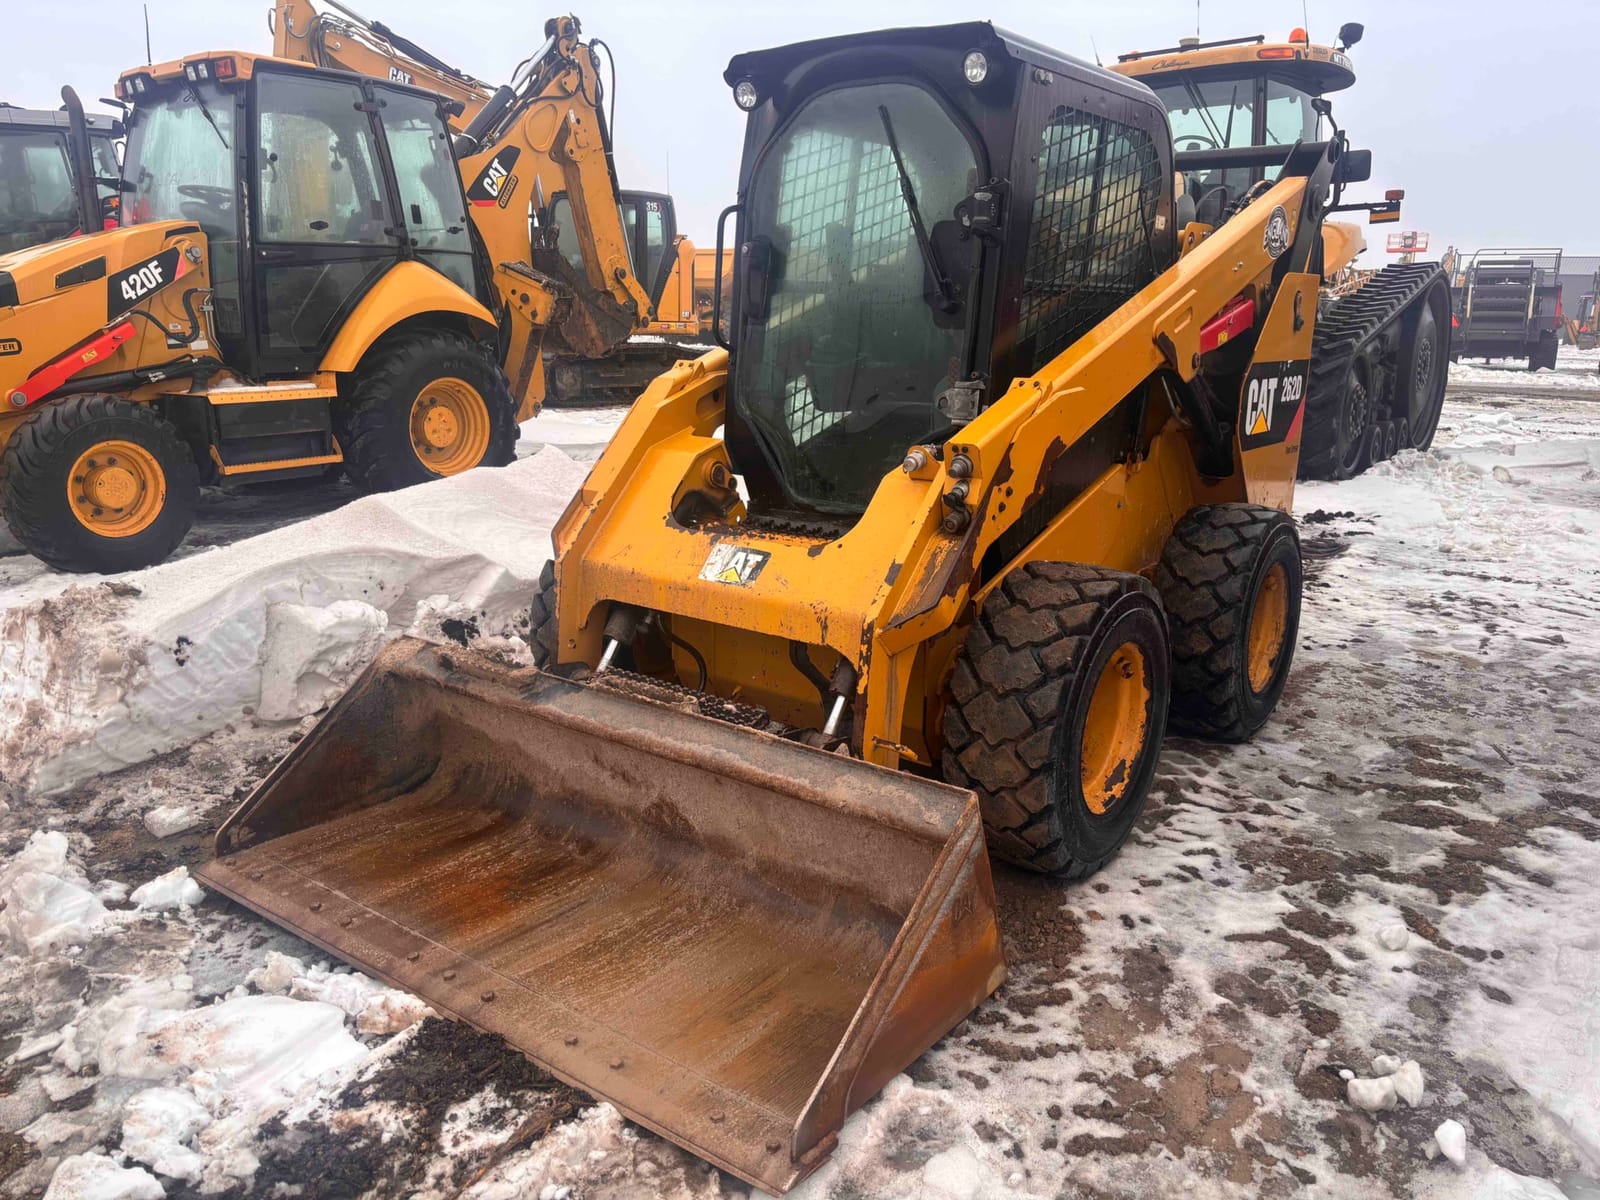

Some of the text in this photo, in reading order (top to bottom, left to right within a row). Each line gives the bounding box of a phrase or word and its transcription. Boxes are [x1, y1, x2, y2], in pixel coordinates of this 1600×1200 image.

[389, 66, 411, 85] CAT
[483, 158, 508, 197] CAT
[646, 201, 658, 211] 315
[121, 260, 163, 300] 420F
[1245, 375, 1303, 436] CAT 262D
[704, 549, 764, 581] AT
